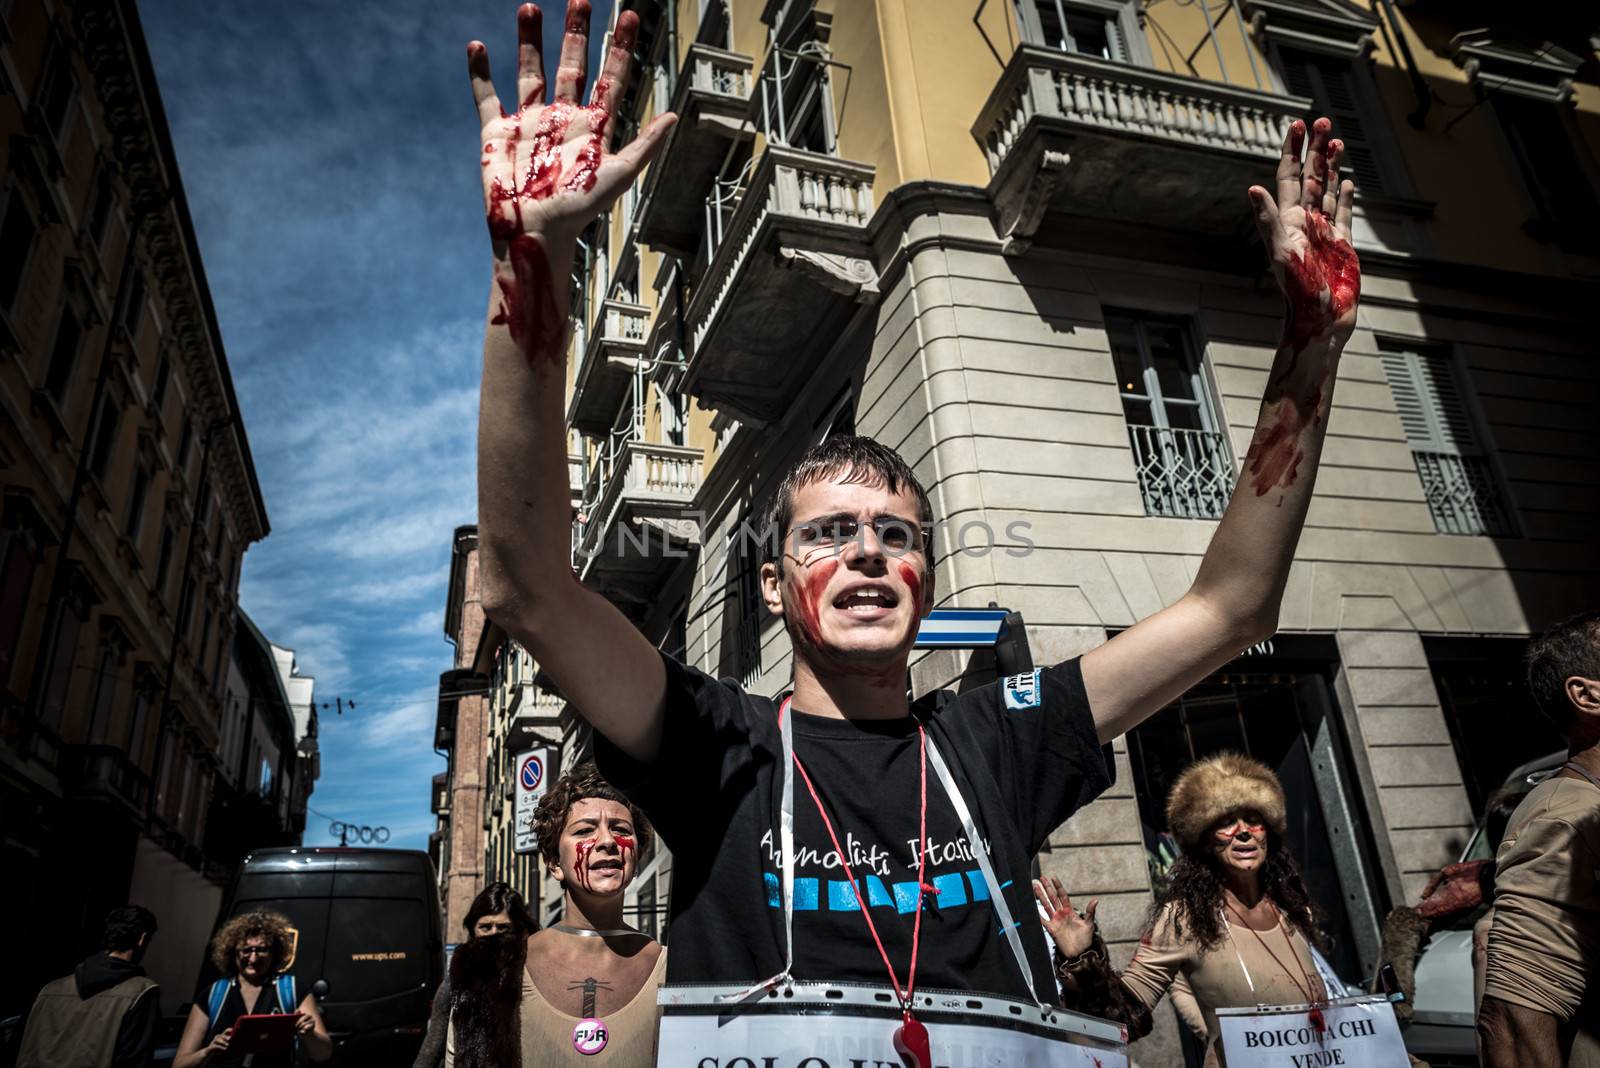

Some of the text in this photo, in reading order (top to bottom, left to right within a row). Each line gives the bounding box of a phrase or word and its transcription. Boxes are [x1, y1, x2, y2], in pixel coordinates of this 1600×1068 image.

[352, 952, 406, 962] www.ups.com
[575, 1029, 607, 1042] FUR
[1339, 1019, 1376, 1039] CHI
[1291, 1049, 1345, 1068] VENDE
